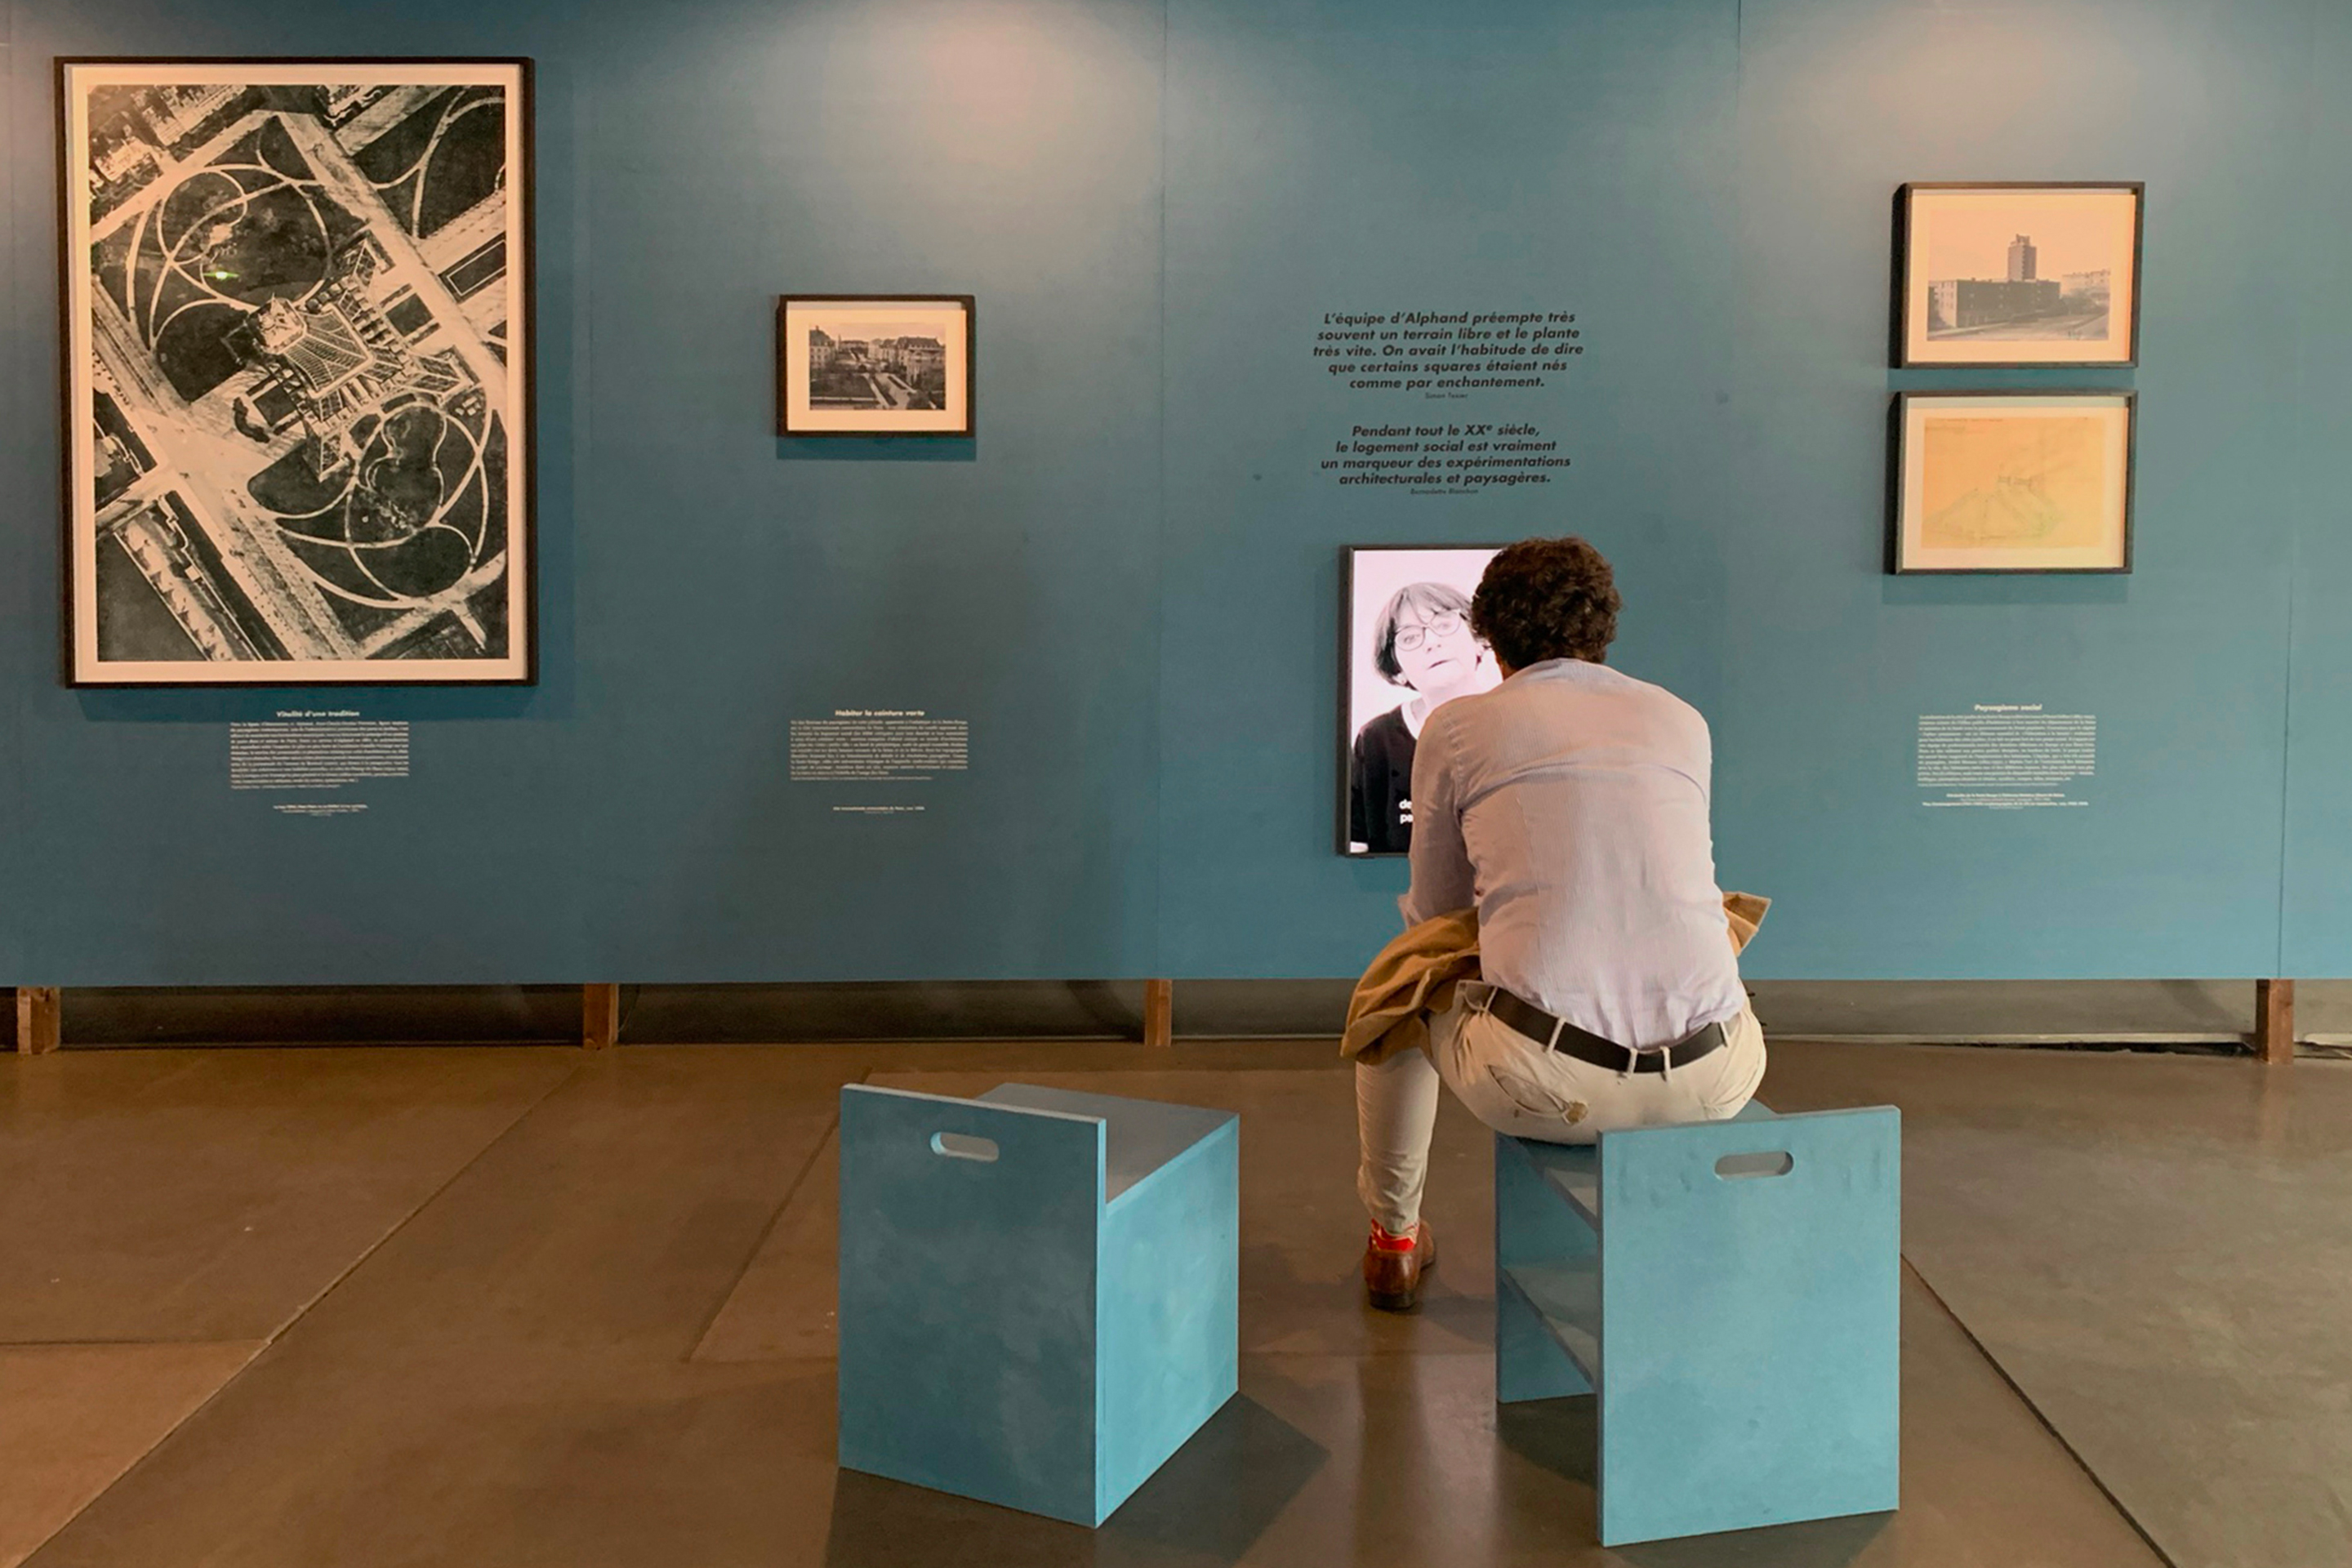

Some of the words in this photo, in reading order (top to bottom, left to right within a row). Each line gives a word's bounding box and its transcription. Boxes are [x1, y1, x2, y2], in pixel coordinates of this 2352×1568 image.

[1472, 312, 1543, 325] préempte
[1548, 311, 1575, 323] très
[1317, 329, 1374, 341] souvent
[1380, 331, 1397, 340] un
[1404, 328, 1452, 340] terrain
[1458, 327, 1491, 339] libre
[1496, 328, 1510, 339] et
[1516, 327, 1528, 339] le
[1533, 327, 1579, 341] plante
[1313, 345, 1340, 357] très
[1347, 345, 1376, 356] vite.
[1383, 345, 1403, 356] On
[1409, 345, 1446, 356] avait
[1531, 344, 1548, 355] de
[1555, 343, 1584, 354] dire
[1329, 363, 1356, 375] que
[1361, 361, 1418, 372] certains
[1423, 362, 1481, 374] squares
[1486, 359, 1536, 372] étaient
[1543, 359, 1567, 371] nés
[1350, 378, 1401, 389] comme
[1406, 378, 1432, 390] par
[1437, 376, 1544, 388] enchantement.
[1352, 425, 1411, 437] Pendant
[1415, 425, 1443, 436] tout
[1448, 425, 1460, 436] le
[1498, 424, 1539, 437] siècle,
[1336, 441, 1348, 452] le
[1352, 441, 1419, 454] logement
[1423, 440, 1463, 452] social
[1468, 441, 1488, 452] est
[1493, 440, 1556, 452] vraiment
[1321, 459, 1338, 469] un
[1343, 458, 1413, 470] marqueur
[1418, 456, 1441, 468] des
[1447, 456, 1570, 470] expérimentations
[1339, 473, 1441, 484] architecturales
[1447, 474, 1460, 483] et
[1464, 471, 1550, 485] paysagères.
